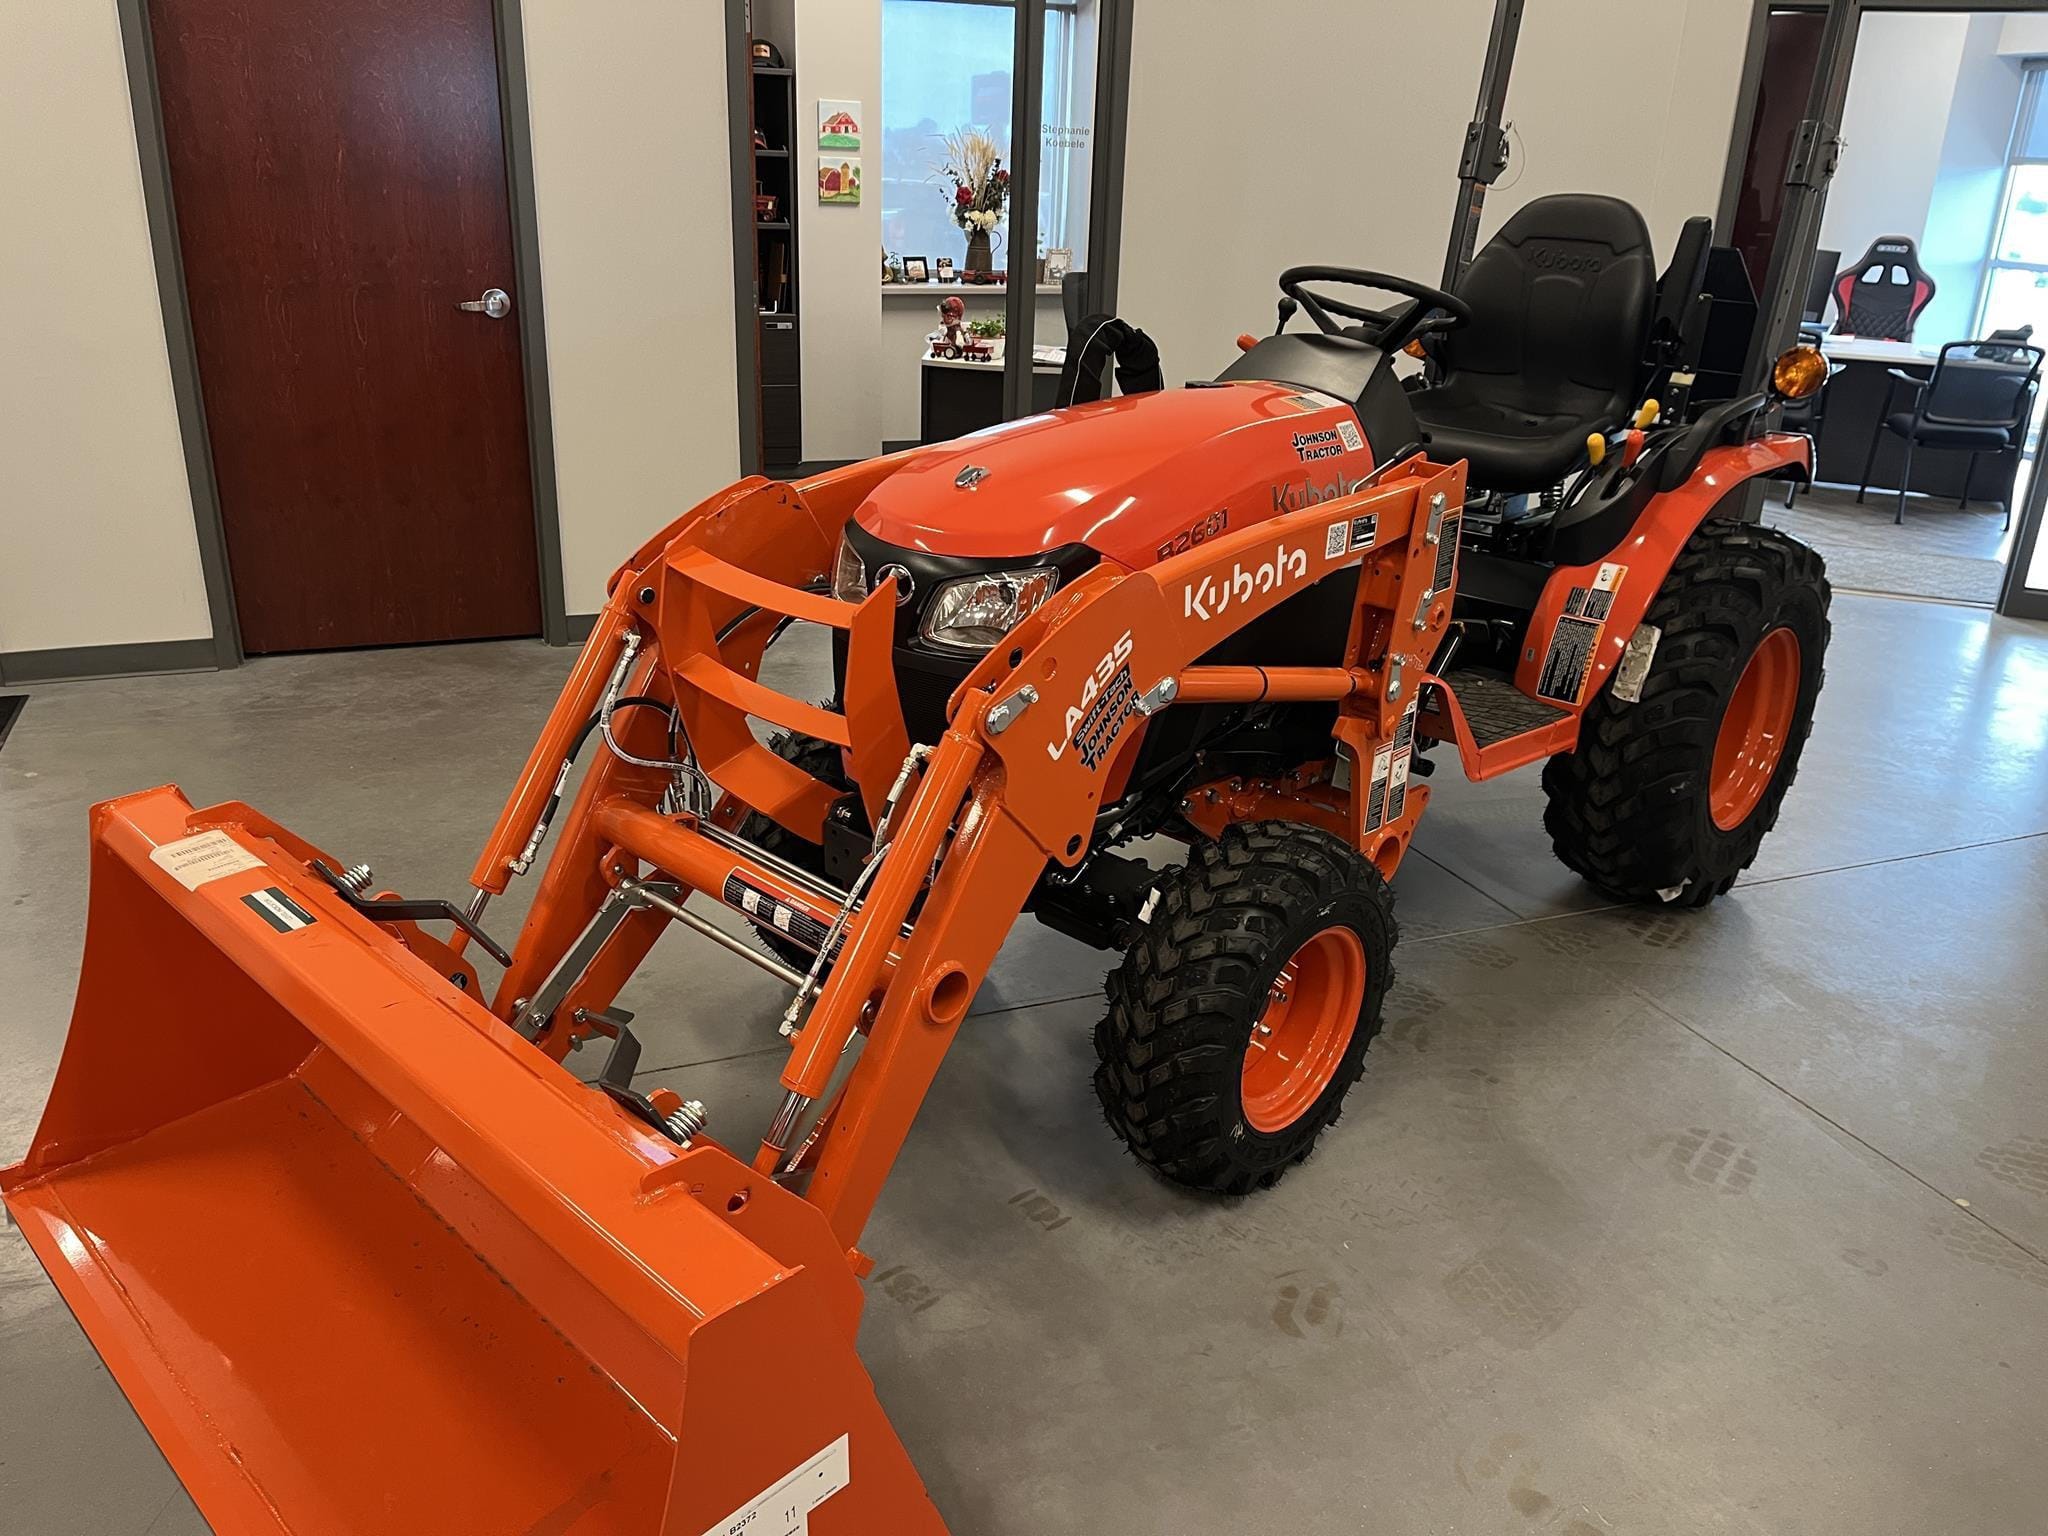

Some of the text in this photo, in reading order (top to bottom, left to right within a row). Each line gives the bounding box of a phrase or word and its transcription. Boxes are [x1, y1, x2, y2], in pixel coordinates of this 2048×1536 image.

[1042, 124, 1090, 136] Stephanie
[1292, 429, 1338, 448] JOHNSON
[1296, 444, 1343, 462] TRACTOR
[1184, 543, 1307, 621] Kubota
[1047, 629, 1133, 761] LA435
[1081, 678, 1133, 765] JOHNSON
[1086, 690, 1141, 772] TRACTOR
[785, 1505, 796, 1523] 11
